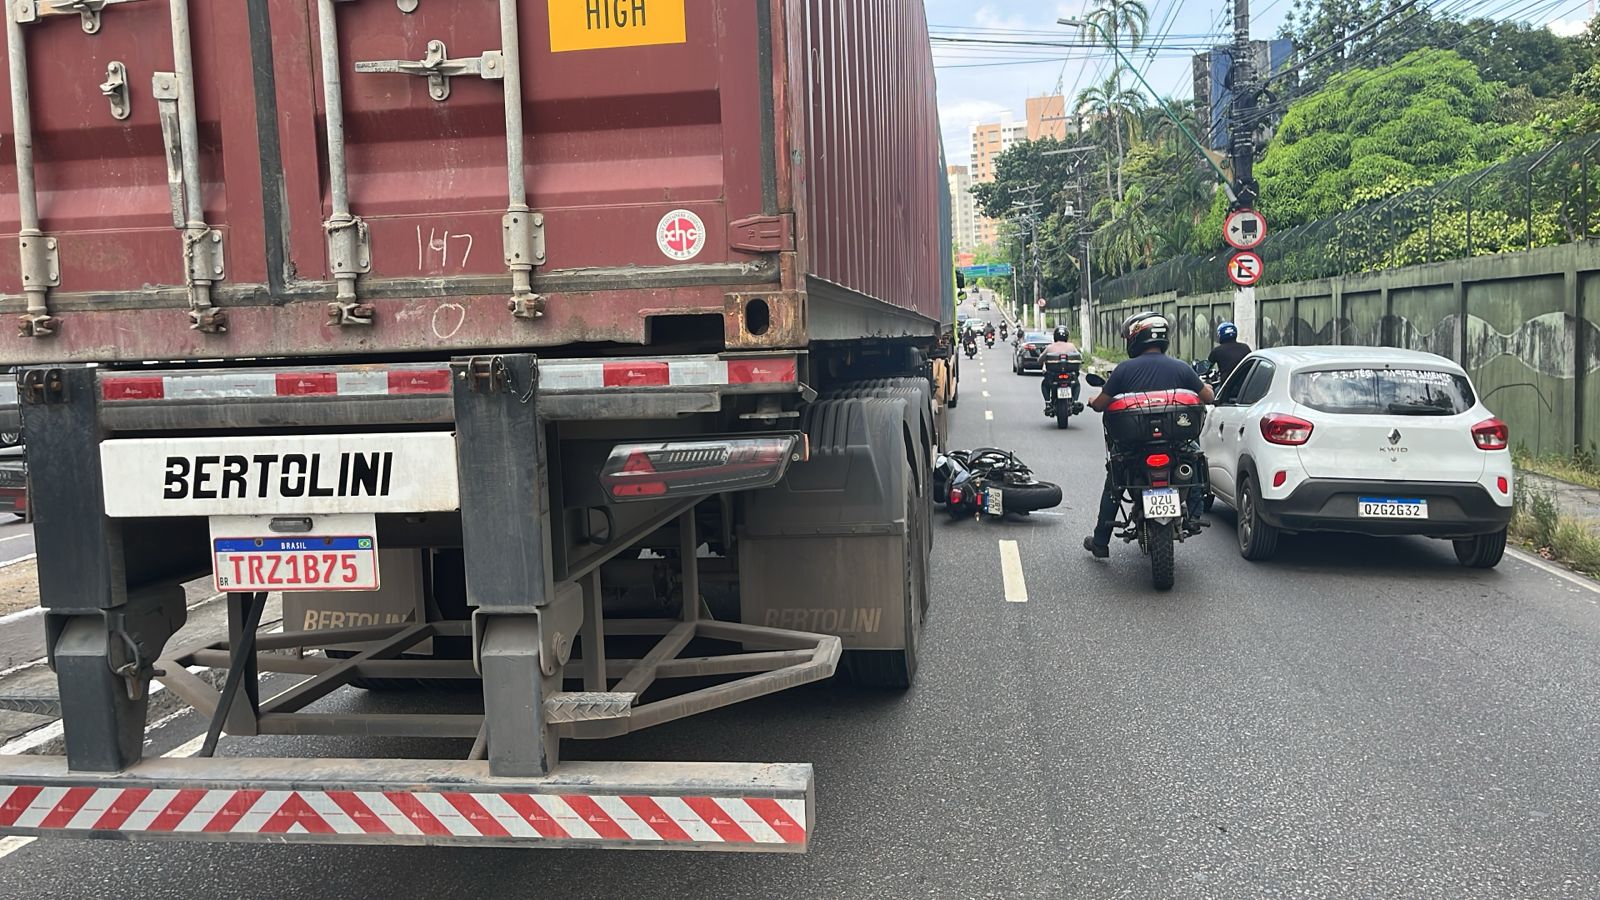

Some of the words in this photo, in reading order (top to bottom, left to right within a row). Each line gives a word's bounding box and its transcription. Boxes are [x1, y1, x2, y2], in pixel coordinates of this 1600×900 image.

[585, 0, 647, 30] HIGH
[416, 225, 473, 271] 147
[1236, 259, 1254, 278] E
[163, 451, 393, 499] BERTOLINI
[1149, 504, 1176, 516] 4C93
[1150, 495, 1172, 505] QZU
[1364, 503, 1421, 516] QZG2G32
[281, 542, 307, 550] BRASIL
[228, 553, 358, 585] TRZ1B75
[219, 577, 229, 587] BR
[303, 609, 408, 631] BERTOLIN
[763, 607, 883, 633] BERTOLINI
